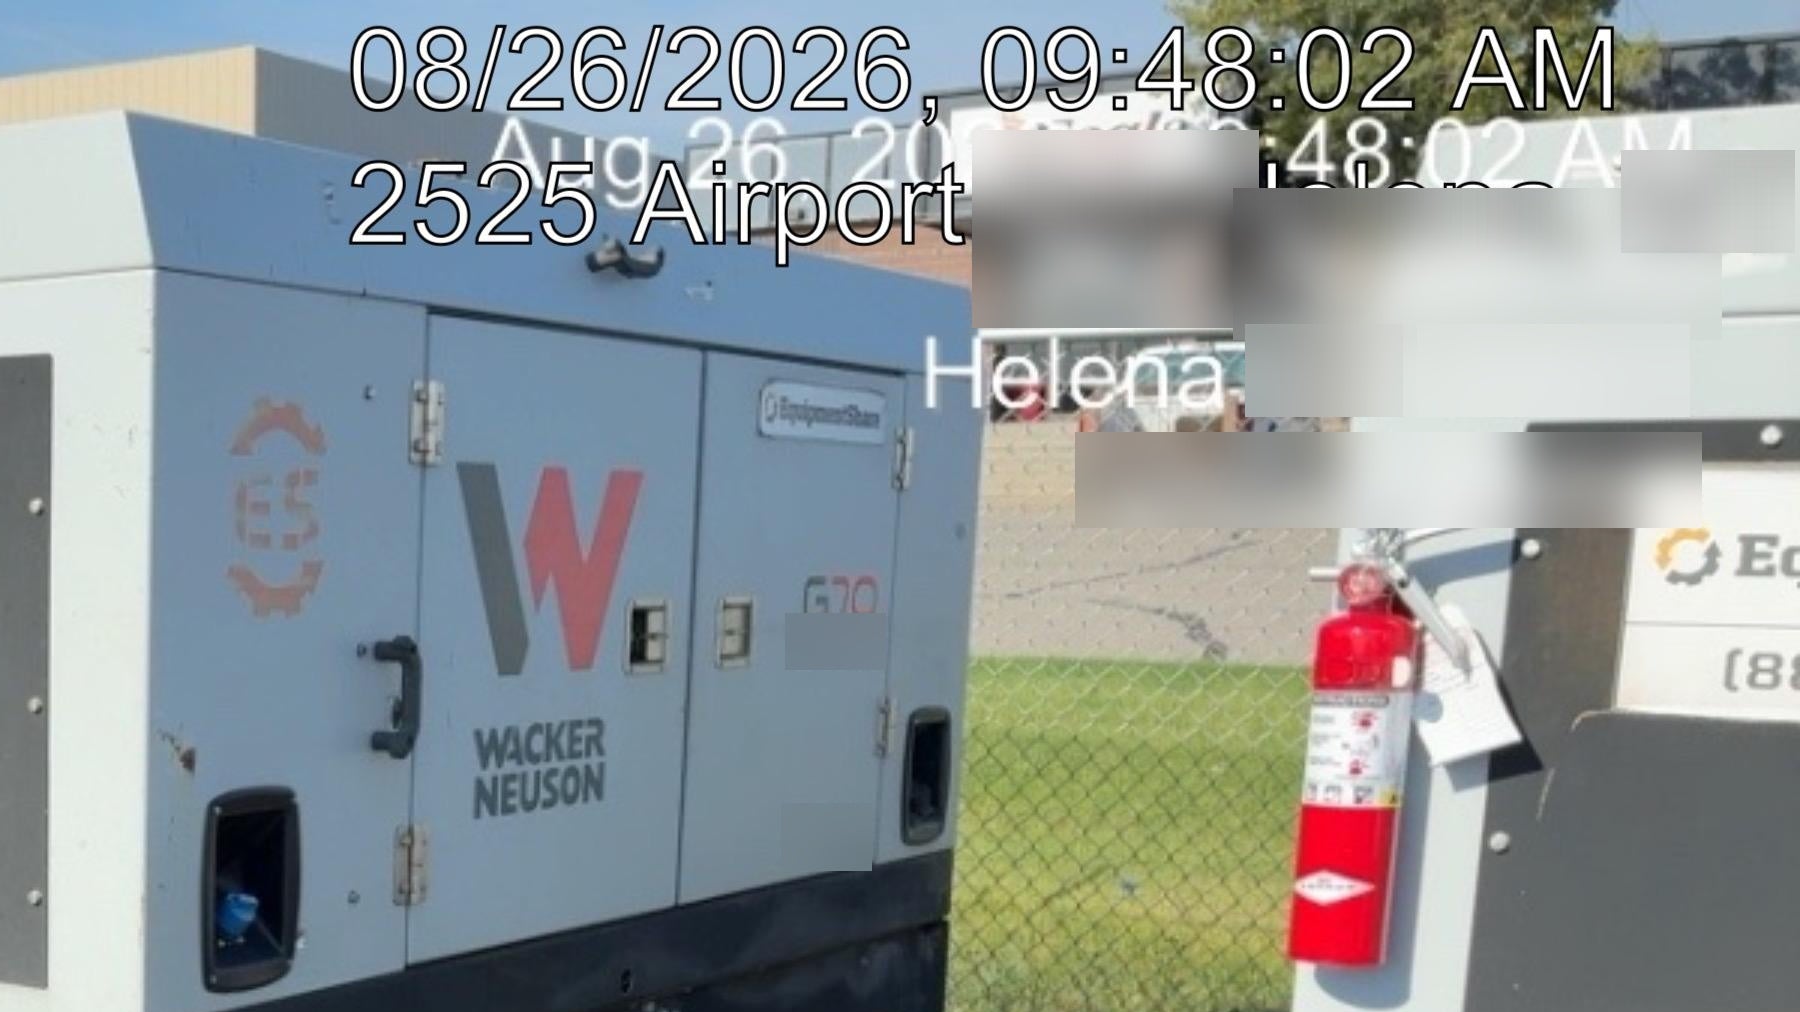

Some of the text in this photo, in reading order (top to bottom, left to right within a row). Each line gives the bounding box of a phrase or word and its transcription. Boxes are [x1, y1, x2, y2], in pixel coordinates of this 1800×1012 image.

[1723, 647, 1800, 693] (8
[473, 717, 607, 772] WACKER
[472, 762, 607, 820] NEUSON
